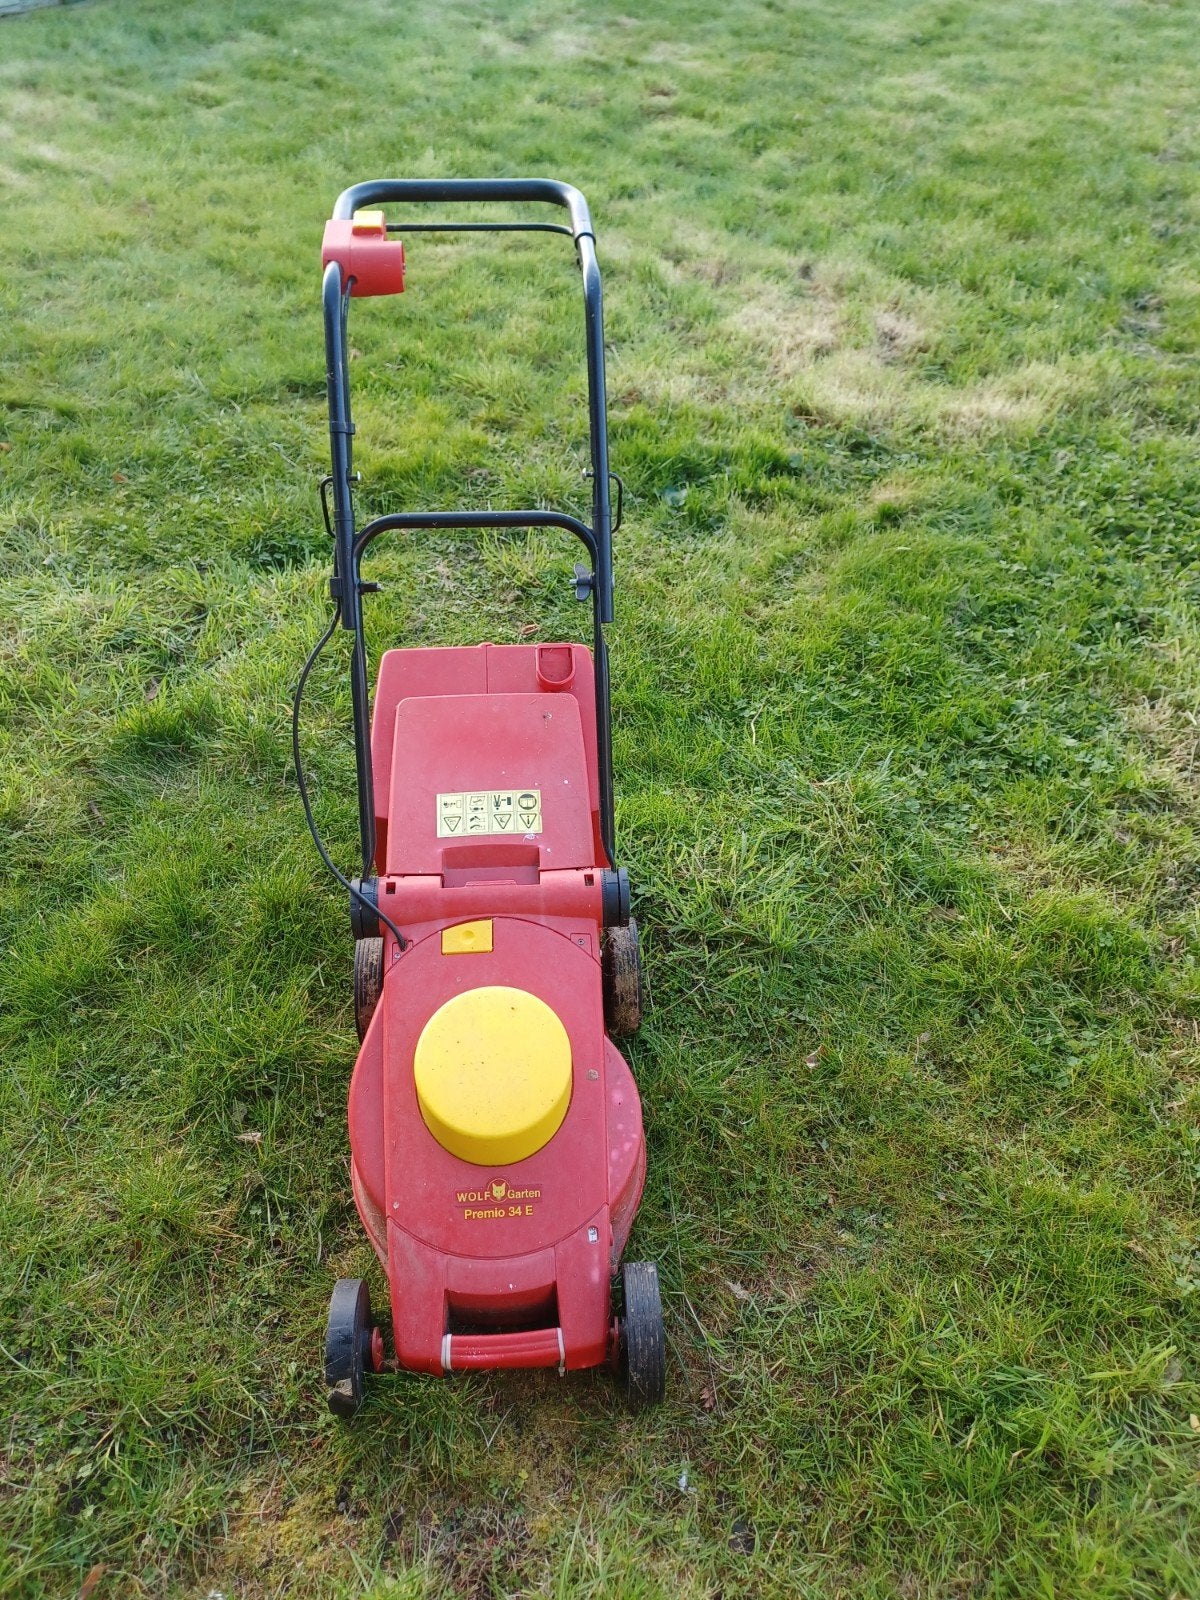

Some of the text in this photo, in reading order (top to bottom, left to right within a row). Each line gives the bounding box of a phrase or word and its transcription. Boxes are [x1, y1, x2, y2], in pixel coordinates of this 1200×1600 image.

[457, 1189, 541, 1202] WOLF Garten
[464, 1205, 533, 1220] Premio 34 E
